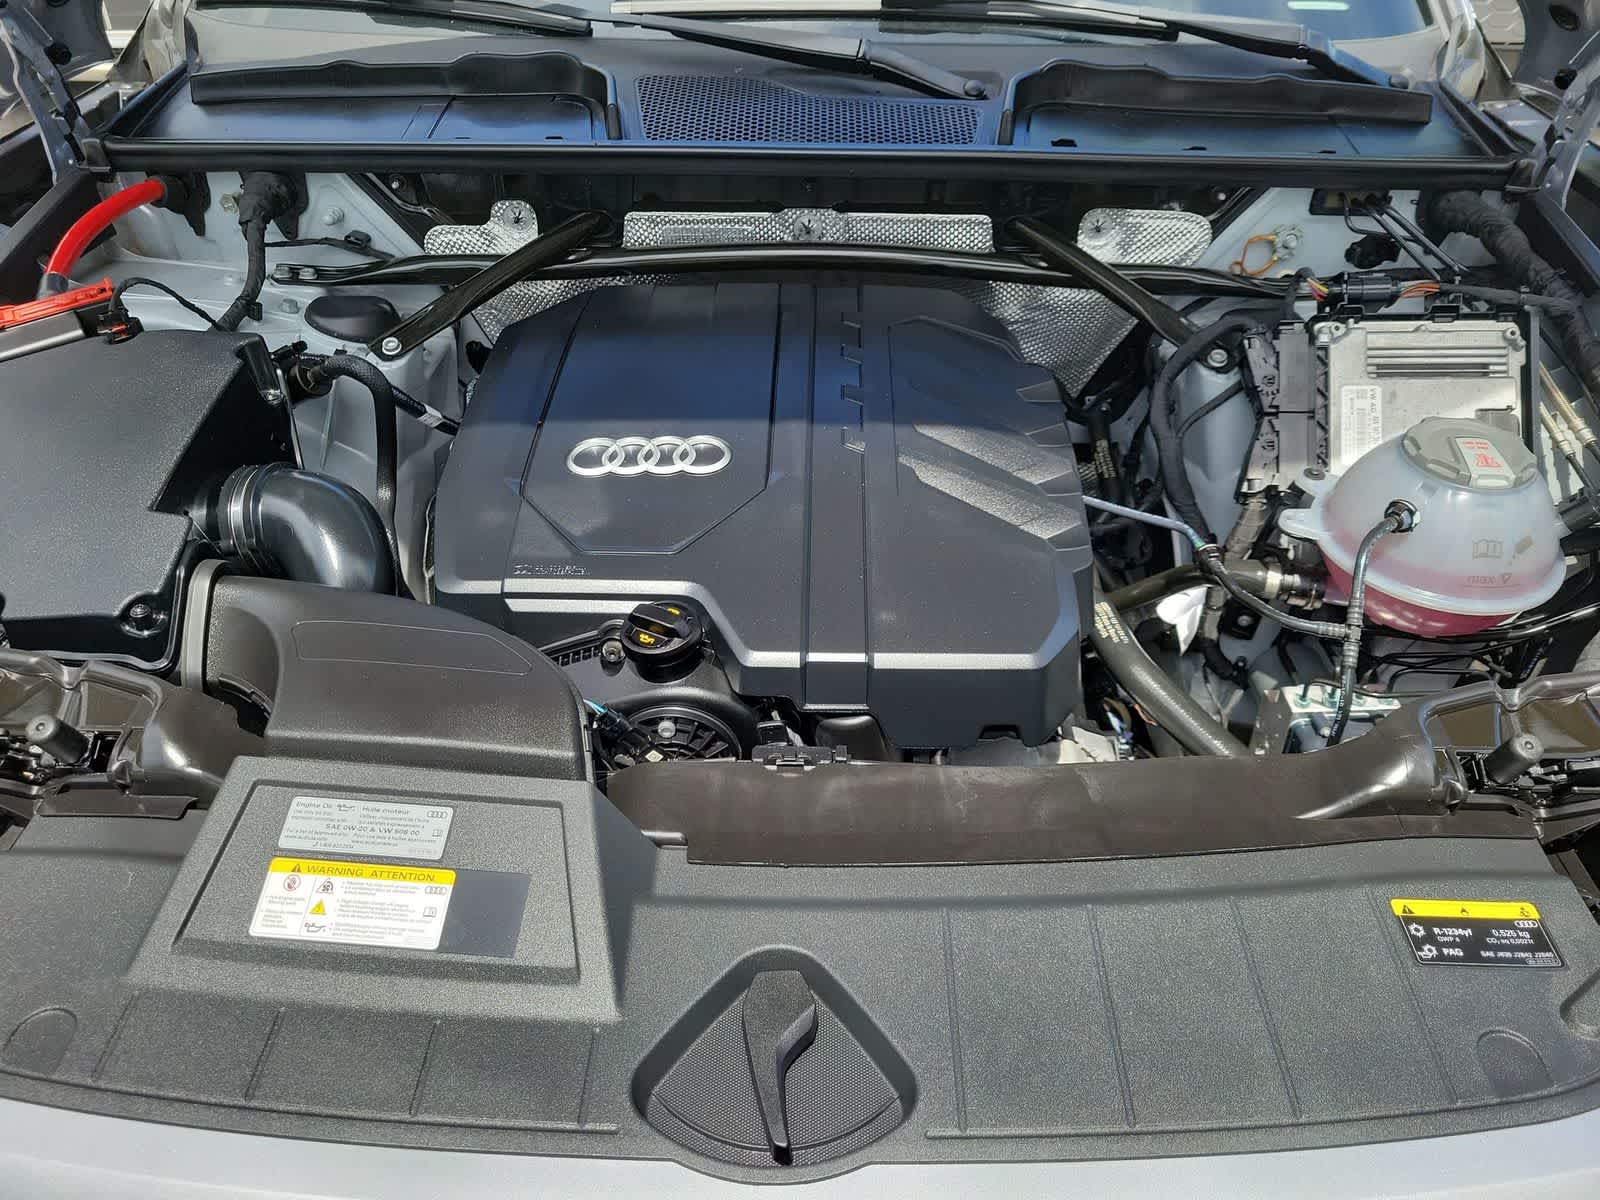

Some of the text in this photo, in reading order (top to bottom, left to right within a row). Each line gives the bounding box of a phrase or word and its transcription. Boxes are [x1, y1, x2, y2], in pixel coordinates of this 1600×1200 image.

[295, 801, 322, 810] Engine
[362, 806, 411, 816] Huile moteur
[325, 823, 340, 831] SAE
[378, 827, 393, 835] VW
[410, 829, 420, 837] 00
[306, 864, 436, 883] WARNING ATTENTION
[1432, 927, 1473, 937] R-1234yf
[1517, 929, 1530, 939] kg
[1441, 947, 1464, 957] PAG
[1480, 950, 1495, 958] SAE
